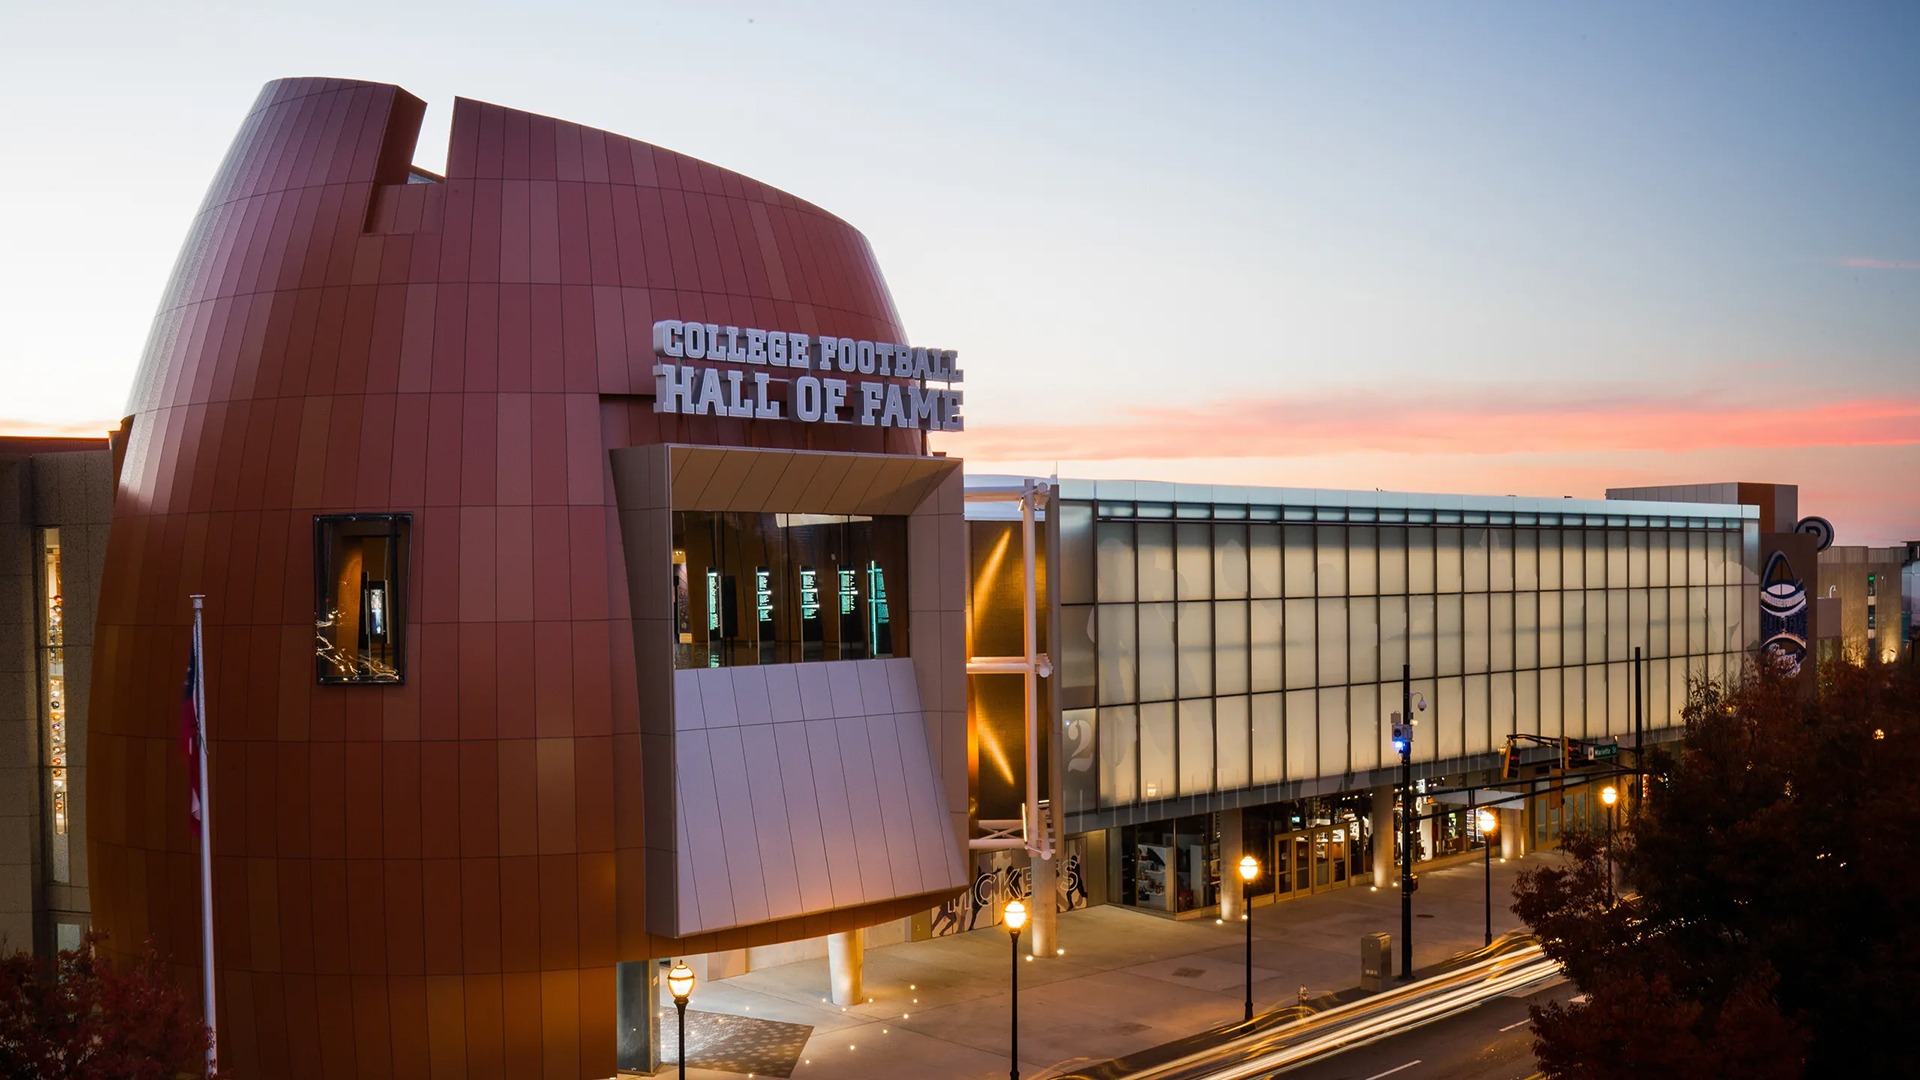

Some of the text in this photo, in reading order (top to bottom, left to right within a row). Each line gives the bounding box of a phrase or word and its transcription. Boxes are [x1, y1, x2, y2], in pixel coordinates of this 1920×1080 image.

[661, 320, 964, 383] COLLEGE FOOTBALL
[660, 364, 965, 432] HALL OF FAME
